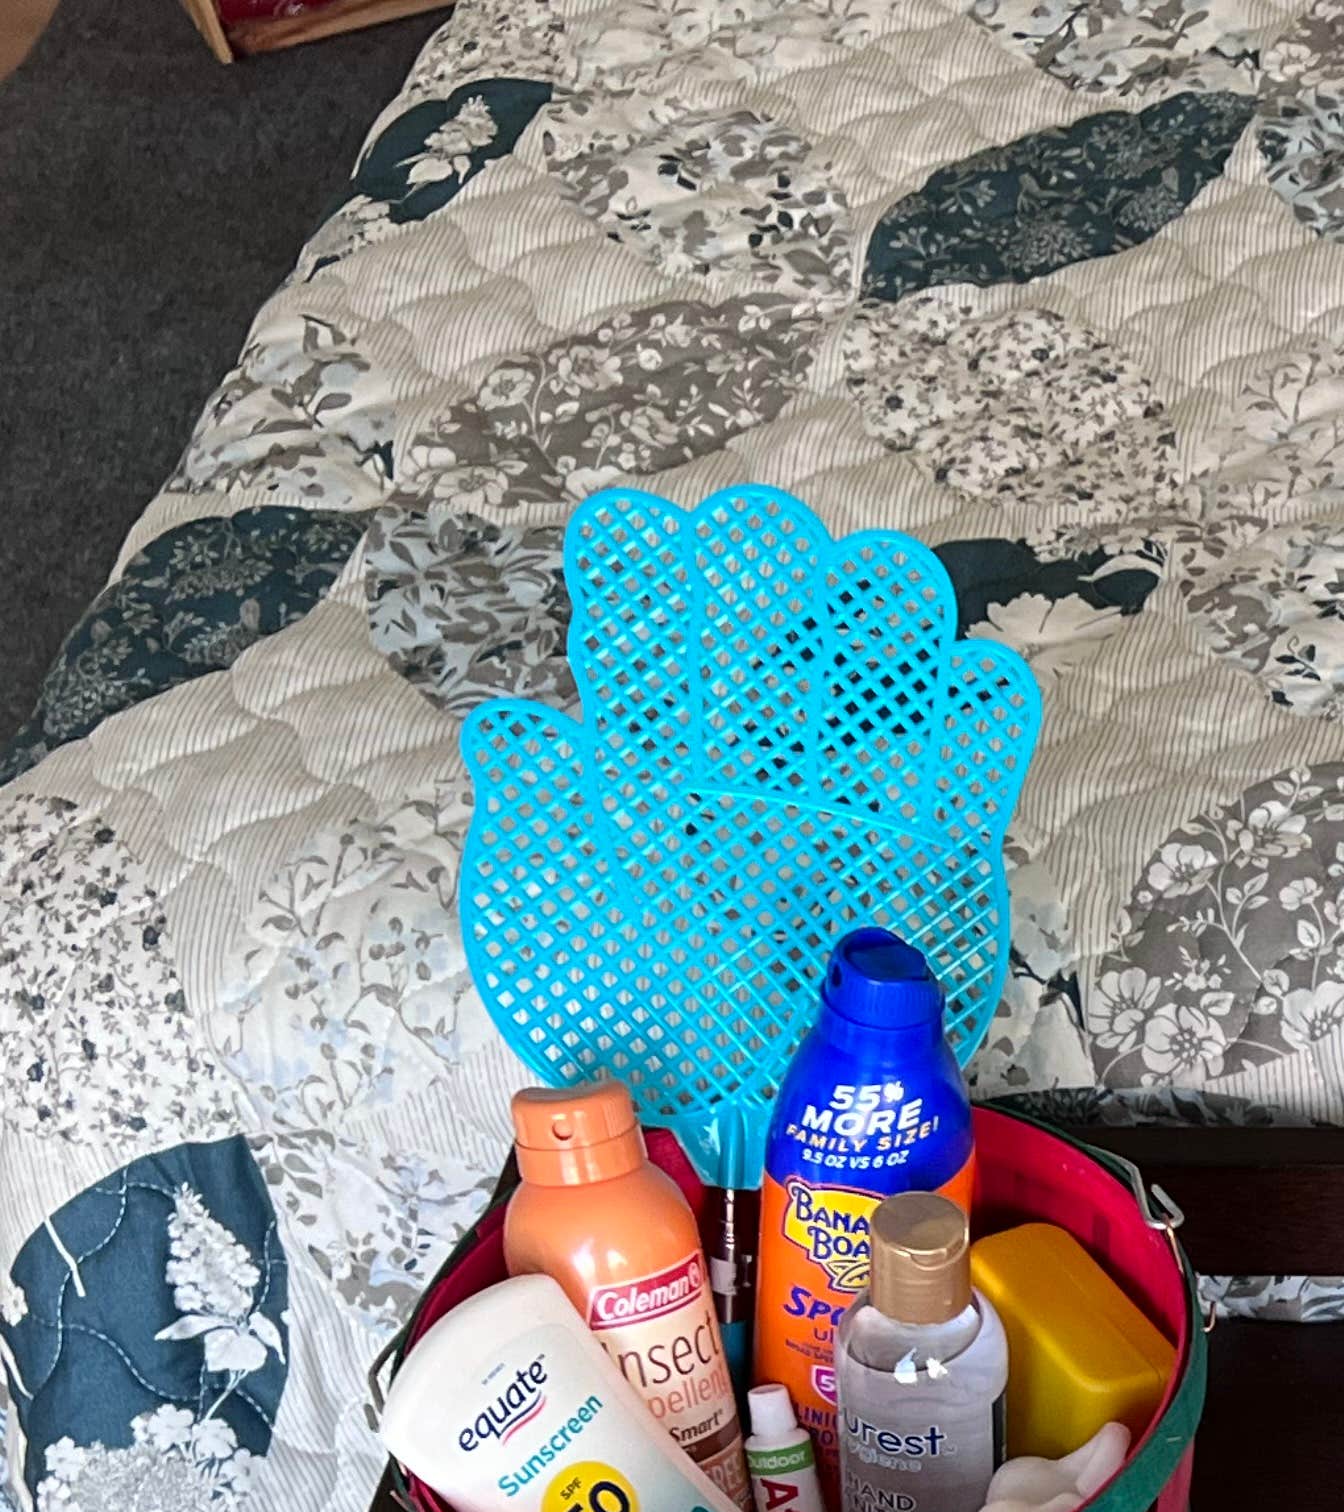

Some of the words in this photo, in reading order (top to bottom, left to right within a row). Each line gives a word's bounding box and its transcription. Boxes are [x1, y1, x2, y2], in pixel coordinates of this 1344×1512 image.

[829, 1081, 904, 1111] 55%
[786, 1123, 867, 1153] FAMILY
[877, 1115, 939, 1151] SIZE!
[801, 1098, 923, 1137] MORE
[824, 1152, 847, 1169] OZ
[850, 1156, 870, 1169] VS
[886, 1150, 909, 1166] OZ
[791, 1186, 870, 1235] BANA
[808, 1225, 870, 1260] BOA
[602, 1310, 720, 1388] nsect
[648, 1368, 728, 1419] pellent
[820, 1373, 837, 1392] 5
[497, 1395, 603, 1497] Sunscreen
[843, 1408, 946, 1456] urest
[560, 1477, 582, 1500] SPF
